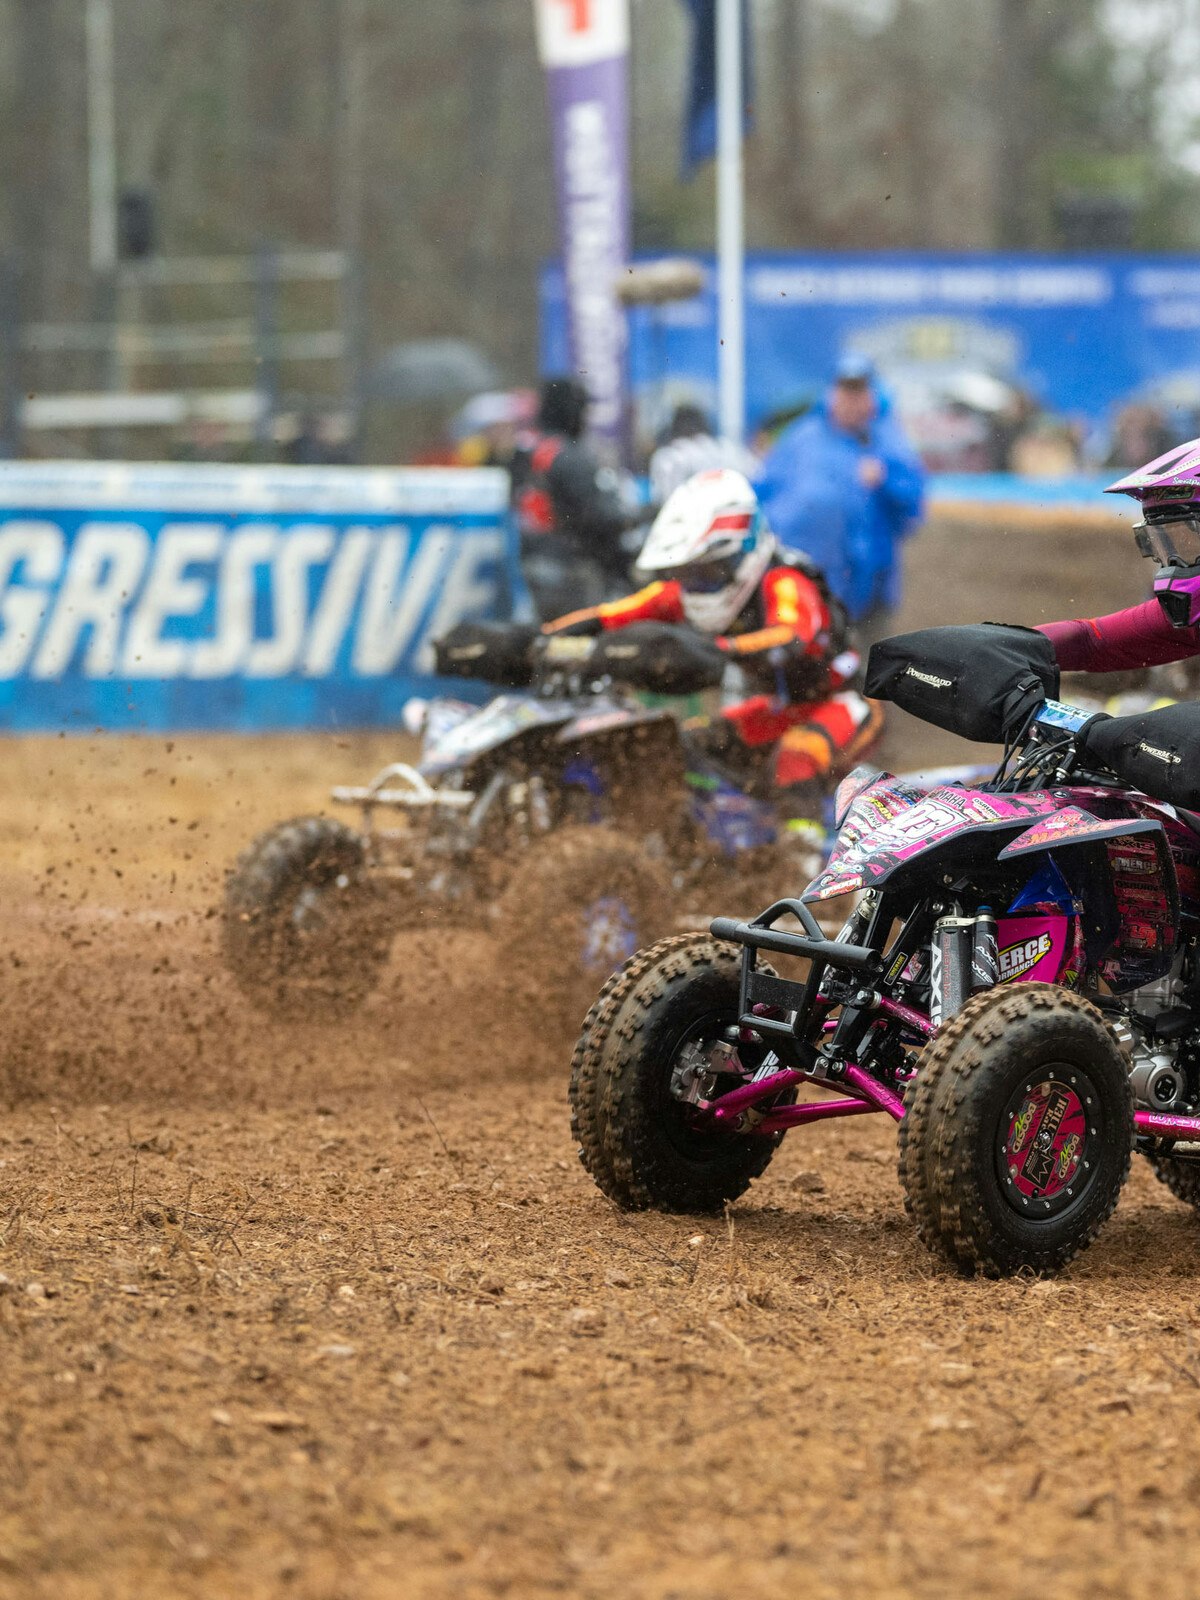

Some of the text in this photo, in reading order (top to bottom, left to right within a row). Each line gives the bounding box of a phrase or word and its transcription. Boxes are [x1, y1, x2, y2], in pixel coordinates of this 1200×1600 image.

[0, 520, 506, 679] GRESSIVE
[938, 786, 966, 809] MAHA
[1000, 934, 1050, 969] ERCE
[999, 958, 1035, 982] RMANCE
